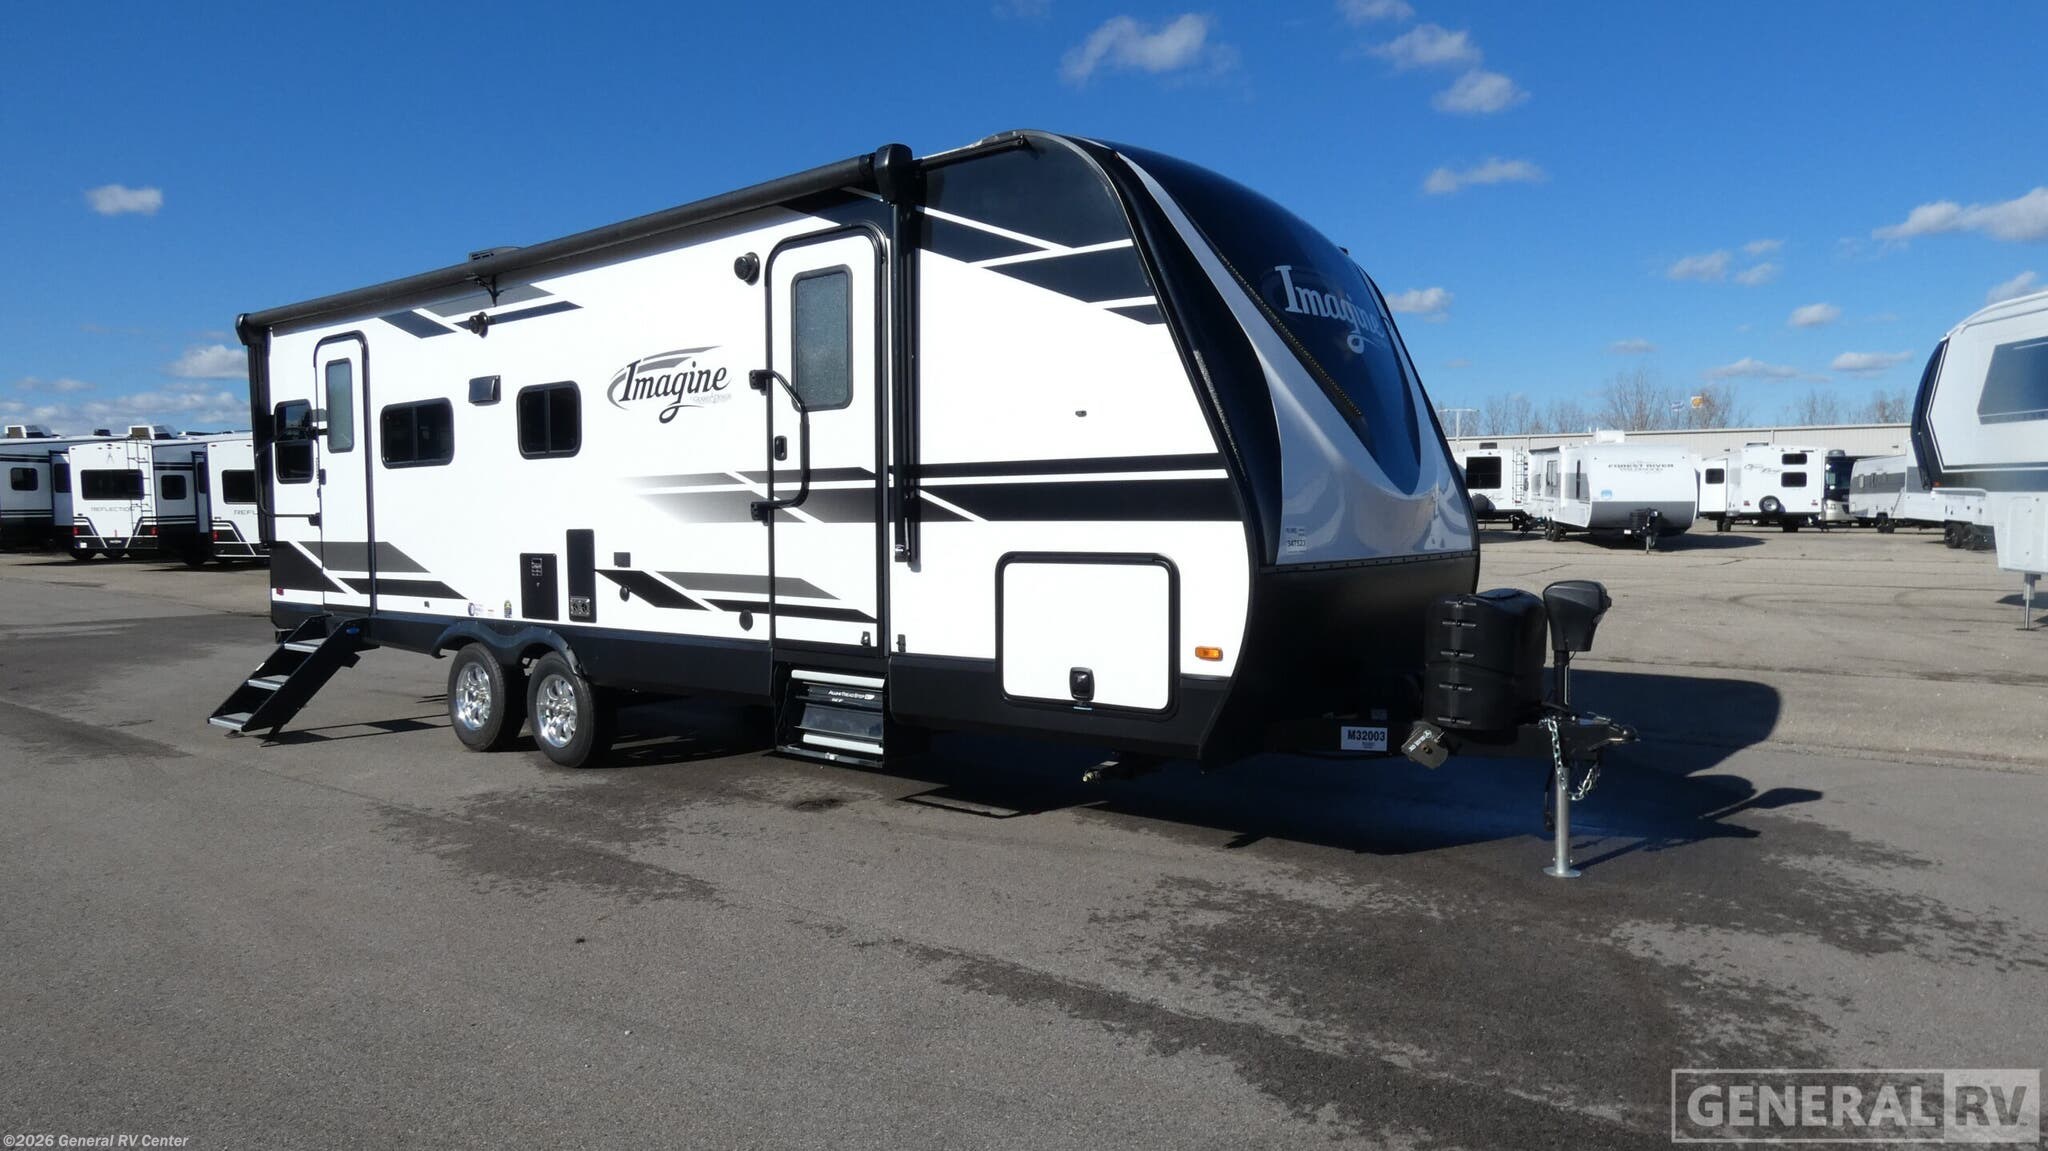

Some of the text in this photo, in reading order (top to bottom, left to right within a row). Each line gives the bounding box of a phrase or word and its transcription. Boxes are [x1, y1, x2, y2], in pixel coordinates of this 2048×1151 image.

[1274, 264, 1384, 354] Imagine
[618, 359, 732, 424] Imagine
[1347, 729, 1385, 741] M32003
